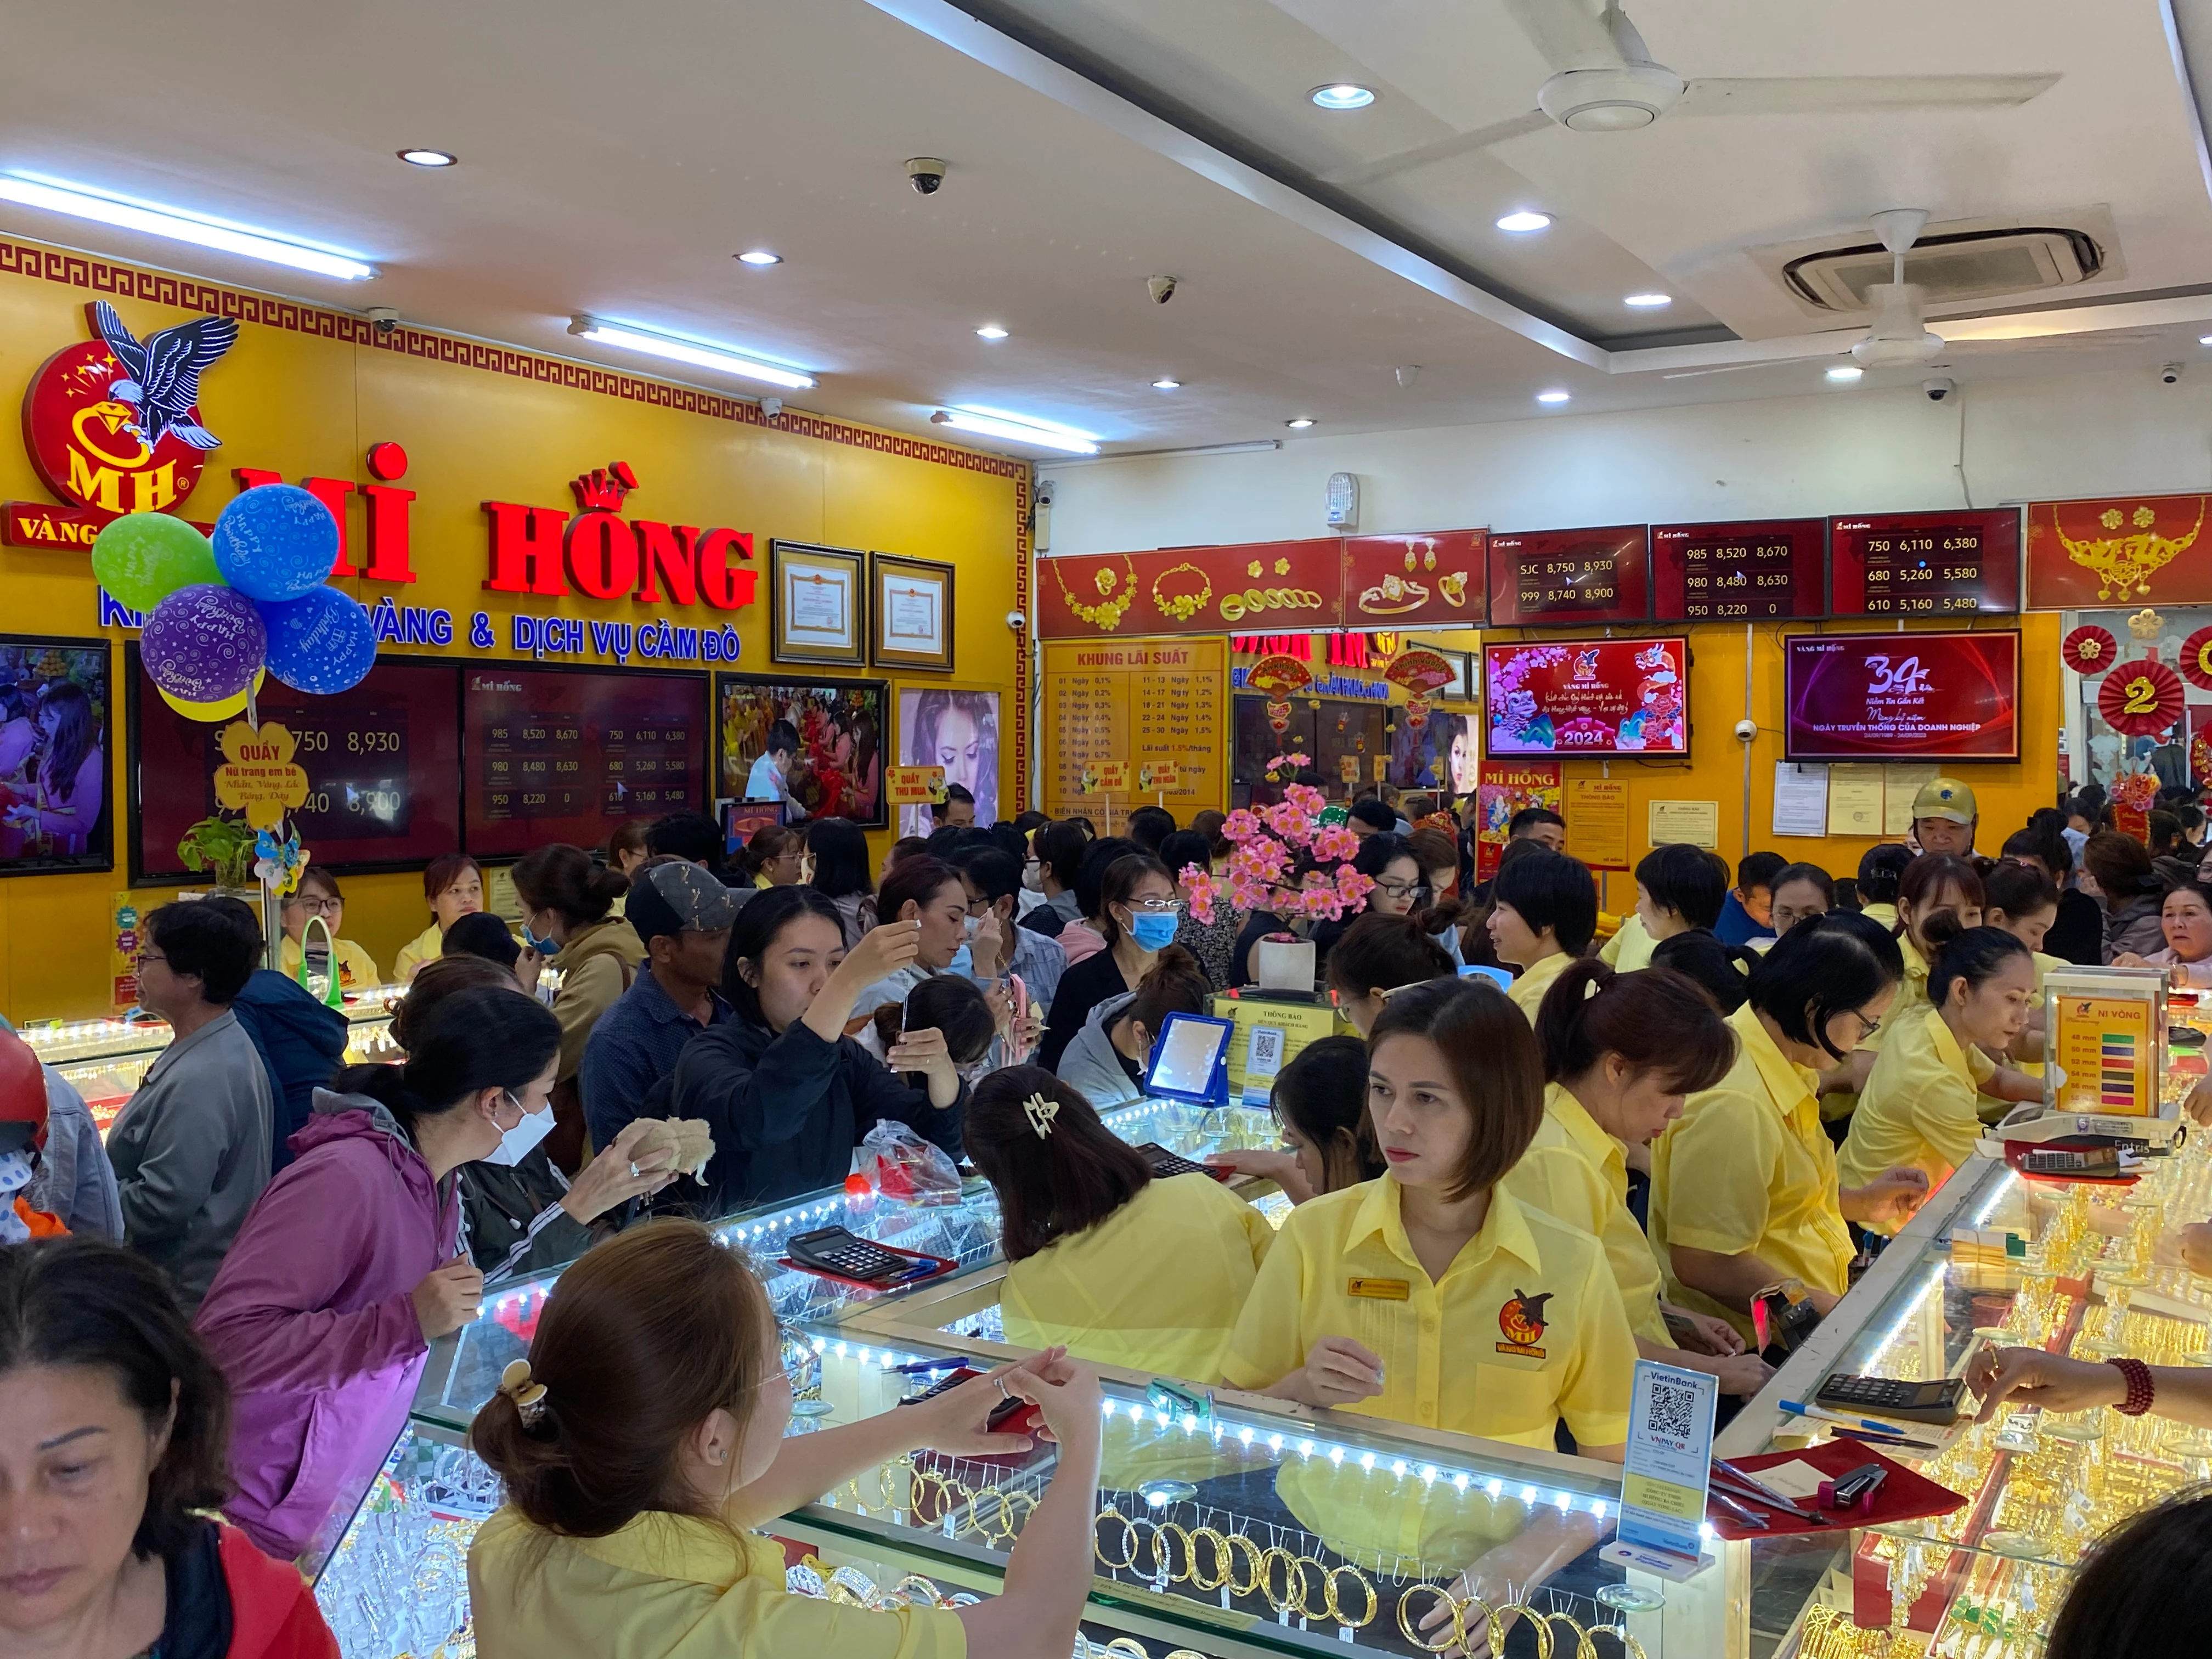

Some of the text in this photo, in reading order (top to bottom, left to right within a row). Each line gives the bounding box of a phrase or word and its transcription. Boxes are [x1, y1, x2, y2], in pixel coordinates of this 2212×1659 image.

[66, 444, 177, 514] MH
[18, 514, 98, 545] VÀNG
[237, 513, 262, 552] HAPPY
[1868, 538, 1977, 552] 750 6,110 6,380
[1687, 546, 1787, 560] 985 8,520 8,670
[1521, 560, 1612, 574] SJC 8,750 8,930
[1688, 575, 1788, 588] 980 8,480 8,630
[1868, 568, 1977, 582] 680 5,260 5,580
[1521, 588, 1613, 601] 999 8,740 8,900
[1688, 603, 1776, 617] 950 8,220 0
[1868, 598, 1977, 612] 610 5,160 5,480
[189, 614, 235, 640] HAPPY
[300, 604, 340, 653] Birthday
[360, 597, 741, 663] VÀNG & DỊCH VỤ CẦM ĐỒ
[333, 630, 358, 666] HAPPY
[1077, 647, 1188, 665] KHUNG LÃI SUẤT
[1274, 663, 1299, 675] Khang
[492, 729, 578, 740] 985 8,520 8,670
[1950, 723, 1981, 732] NGHIỆP
[610, 731, 685, 741] 750 6,110 6,380
[1564, 731, 1603, 746] 2024
[348, 732, 399, 755] 8,930
[225, 767, 239, 777] Nữ
[241, 768, 265, 777] trang
[285, 767, 296, 777] bé
[492, 761, 578, 772] 980 8,480 8,630
[609, 761, 685, 771] 680 5,260 5,580
[636, 791, 656, 802] 5,160
[665, 791, 685, 800] 5,480
[895, 787, 926, 796] THU MUA
[492, 793, 569, 805] 950 8,220 0
[2111, 1009, 2141, 1019] VÒNG
[1650, 1372, 1698, 1389] VietinBank
